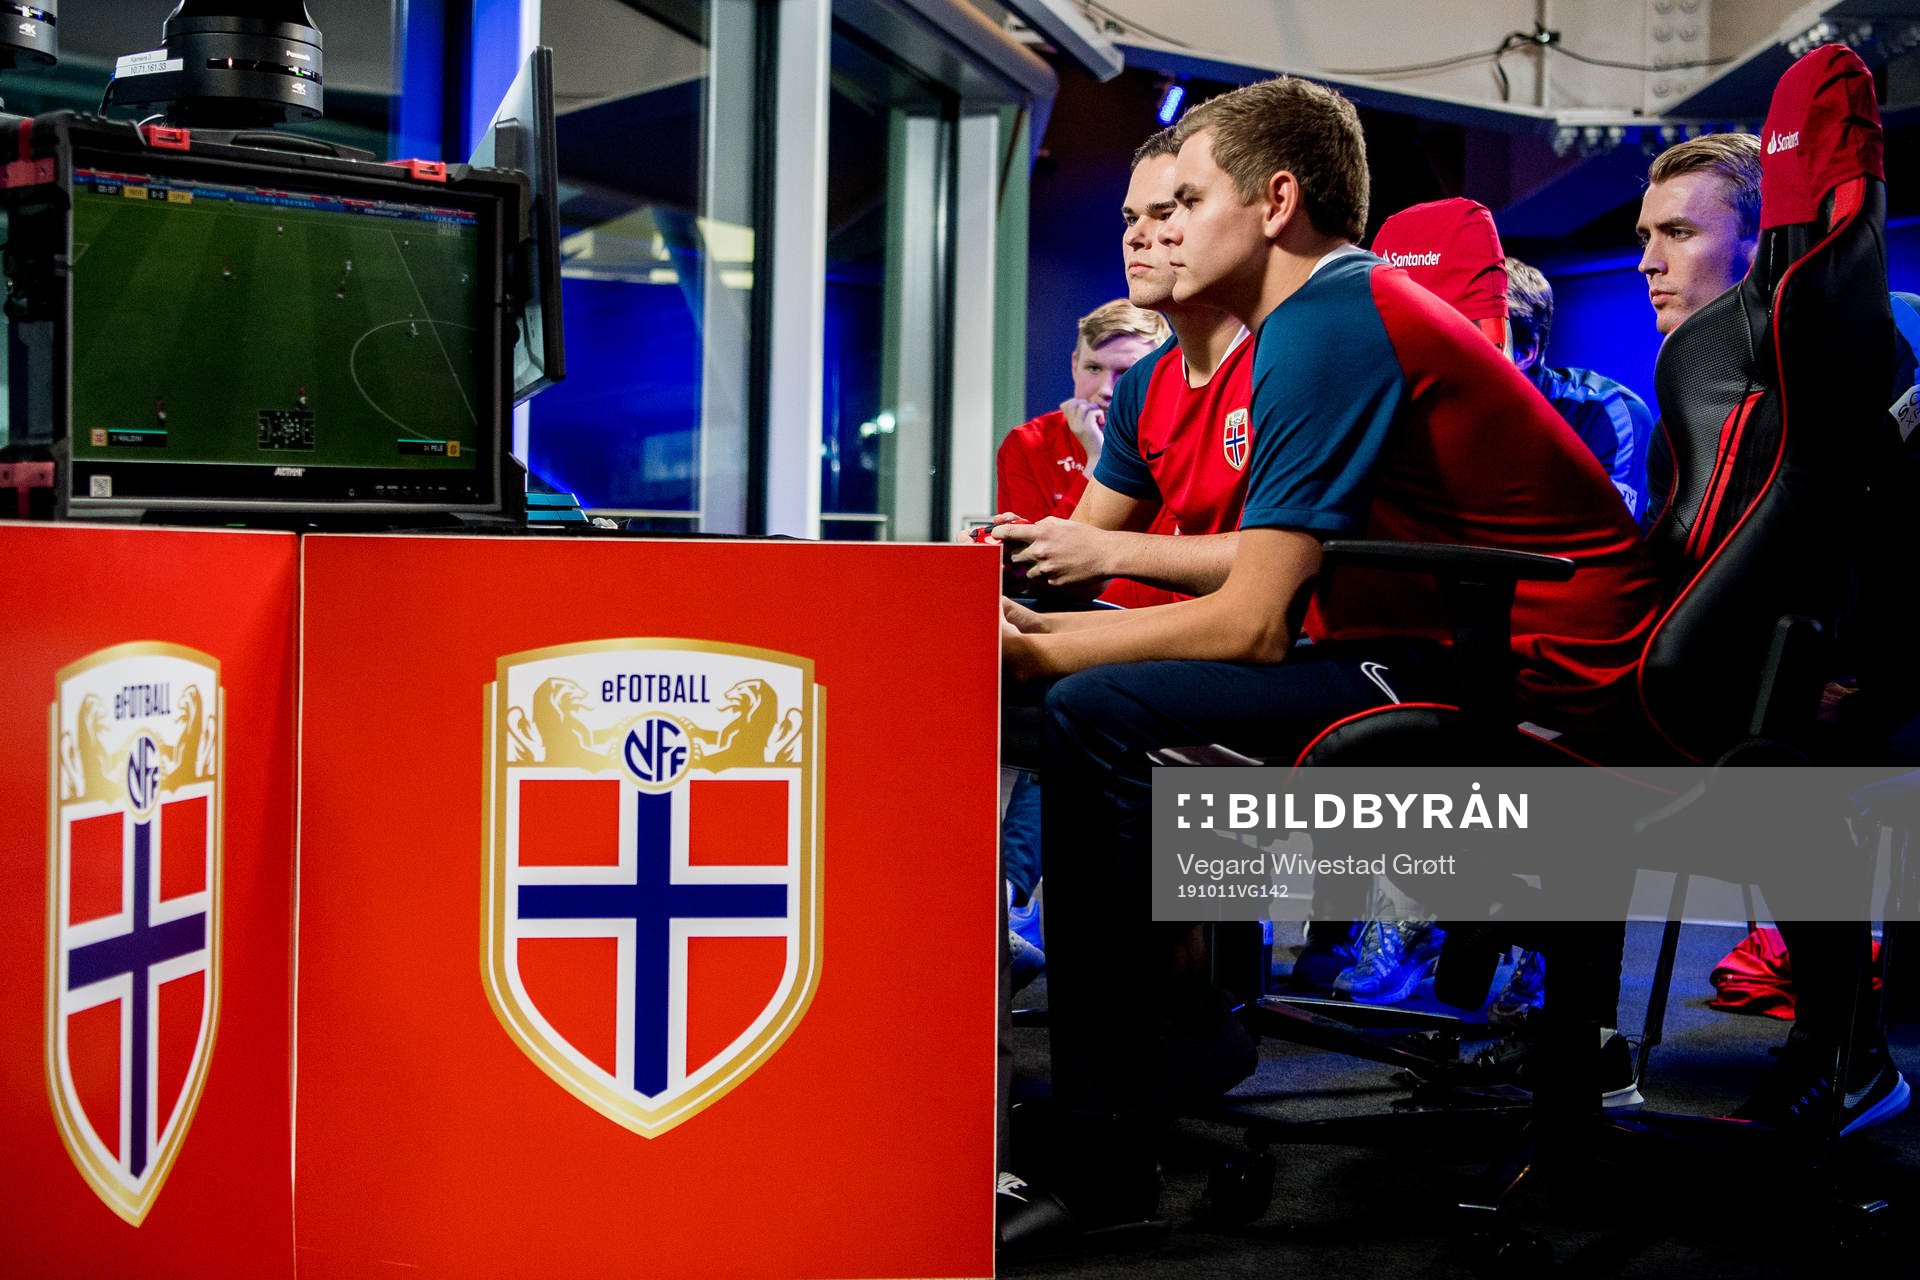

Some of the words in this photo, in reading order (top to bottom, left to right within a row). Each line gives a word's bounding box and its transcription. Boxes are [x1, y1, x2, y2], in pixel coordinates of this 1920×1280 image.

[1391, 250, 1441, 267] Santander
[114, 682, 171, 721] eFOTBALL
[602, 674, 710, 703] eFOTBALL
